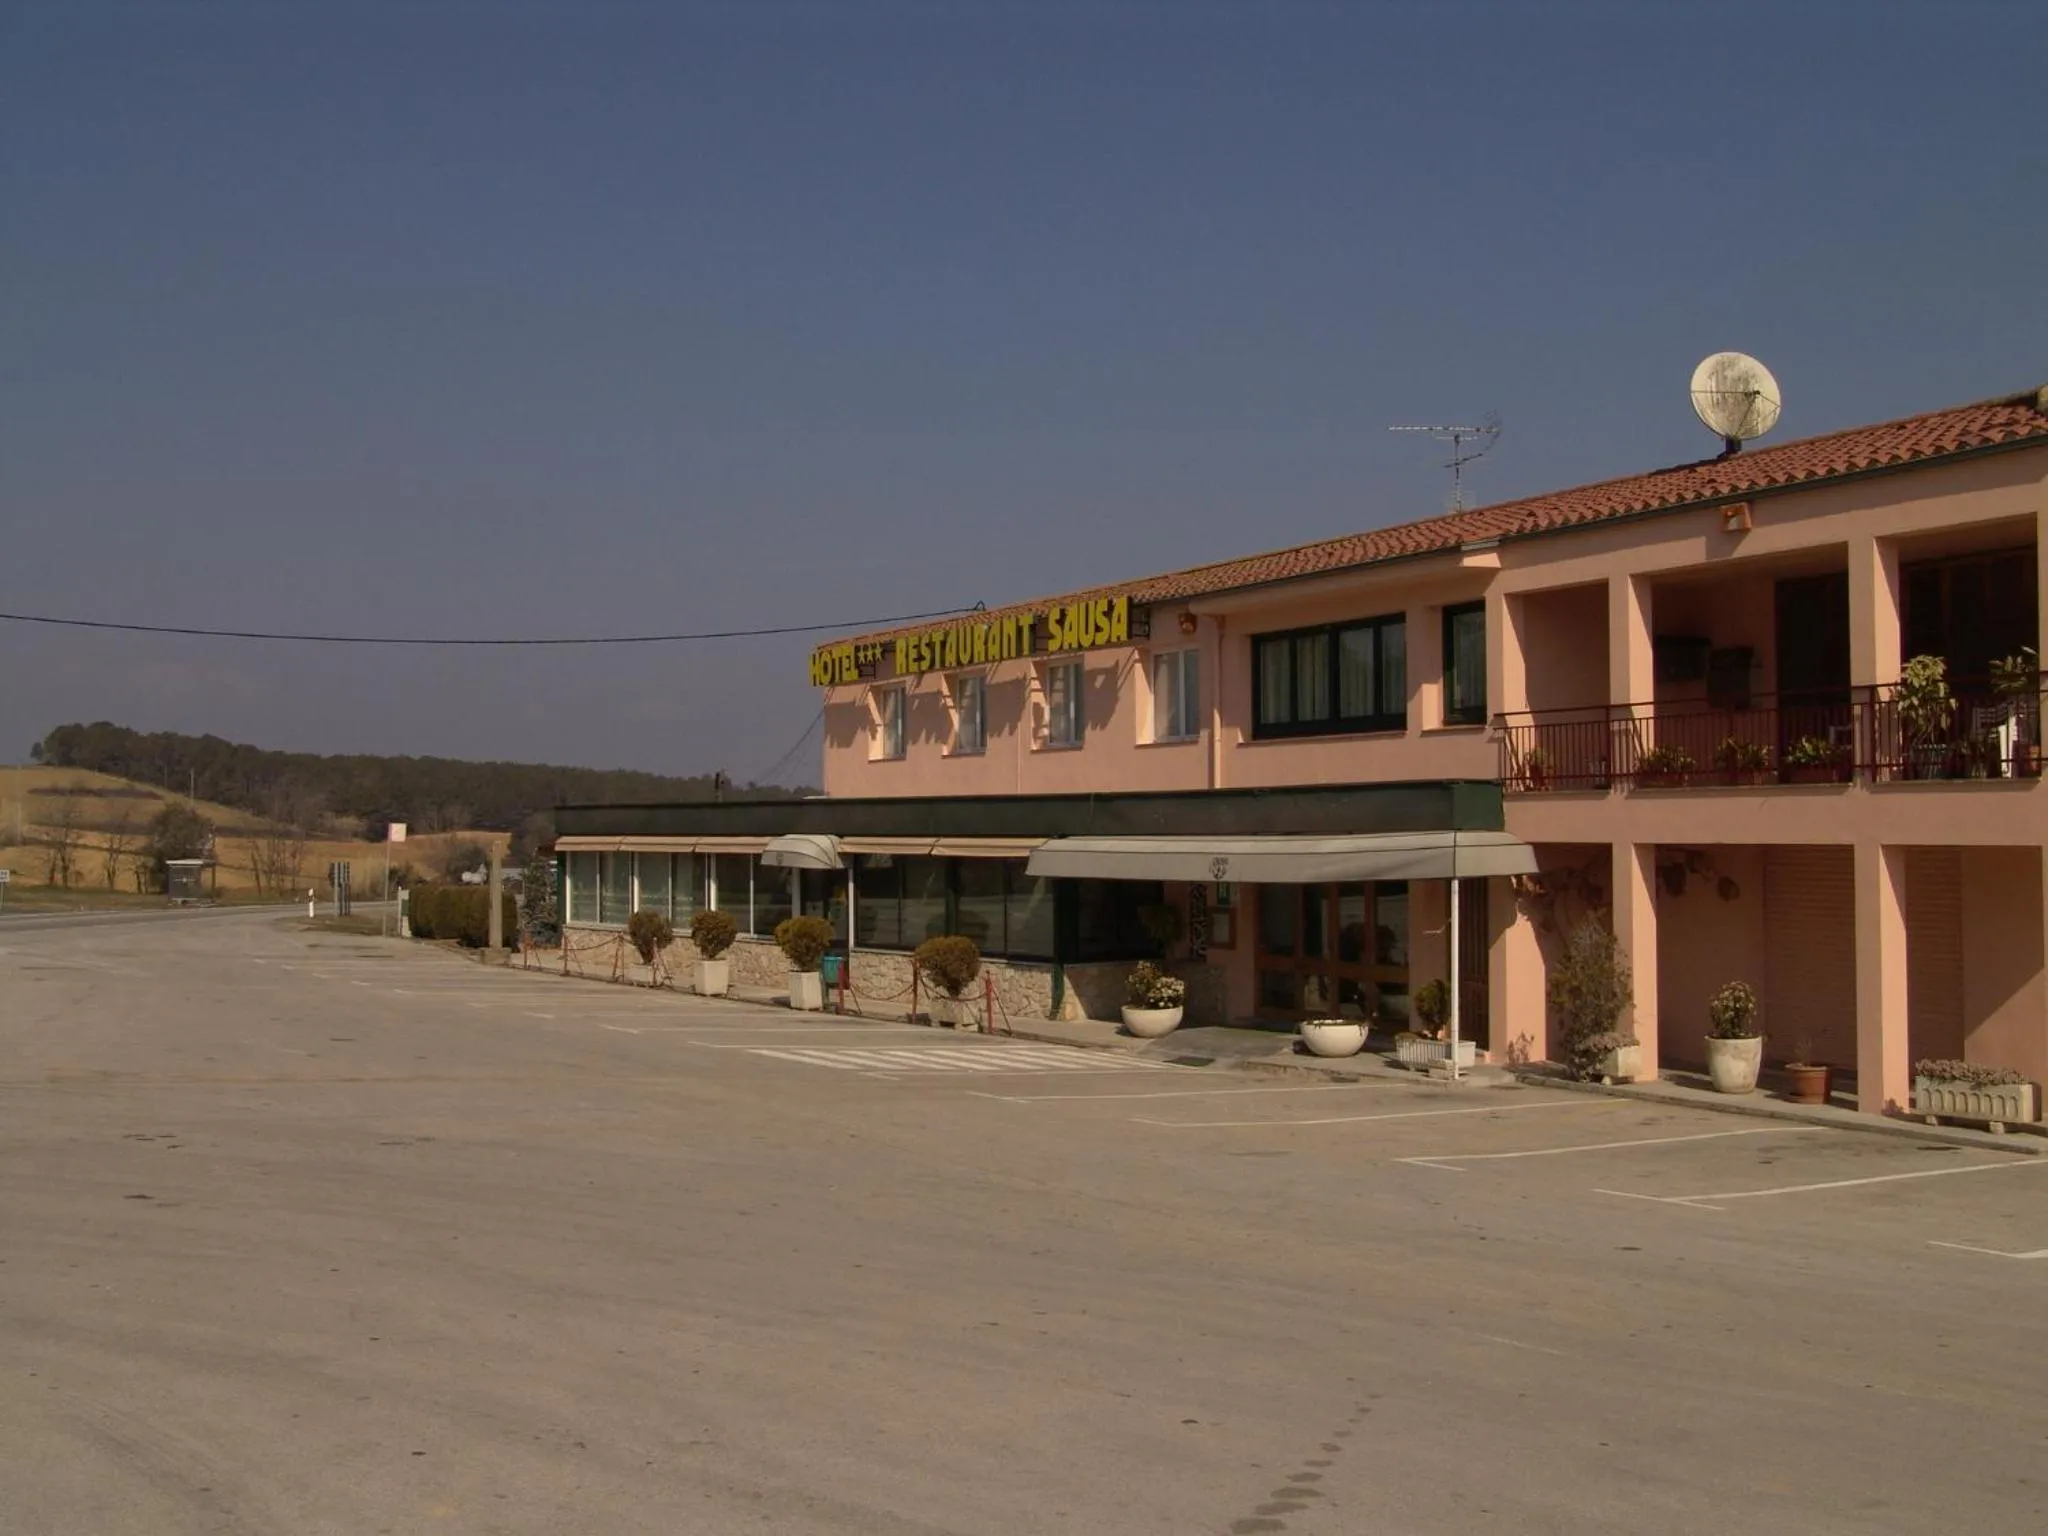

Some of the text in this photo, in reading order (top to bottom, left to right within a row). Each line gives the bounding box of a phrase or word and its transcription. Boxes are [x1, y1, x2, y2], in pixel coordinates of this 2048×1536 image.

[809, 597, 1129, 687] HOTEL RESTAURANT SAUSA
